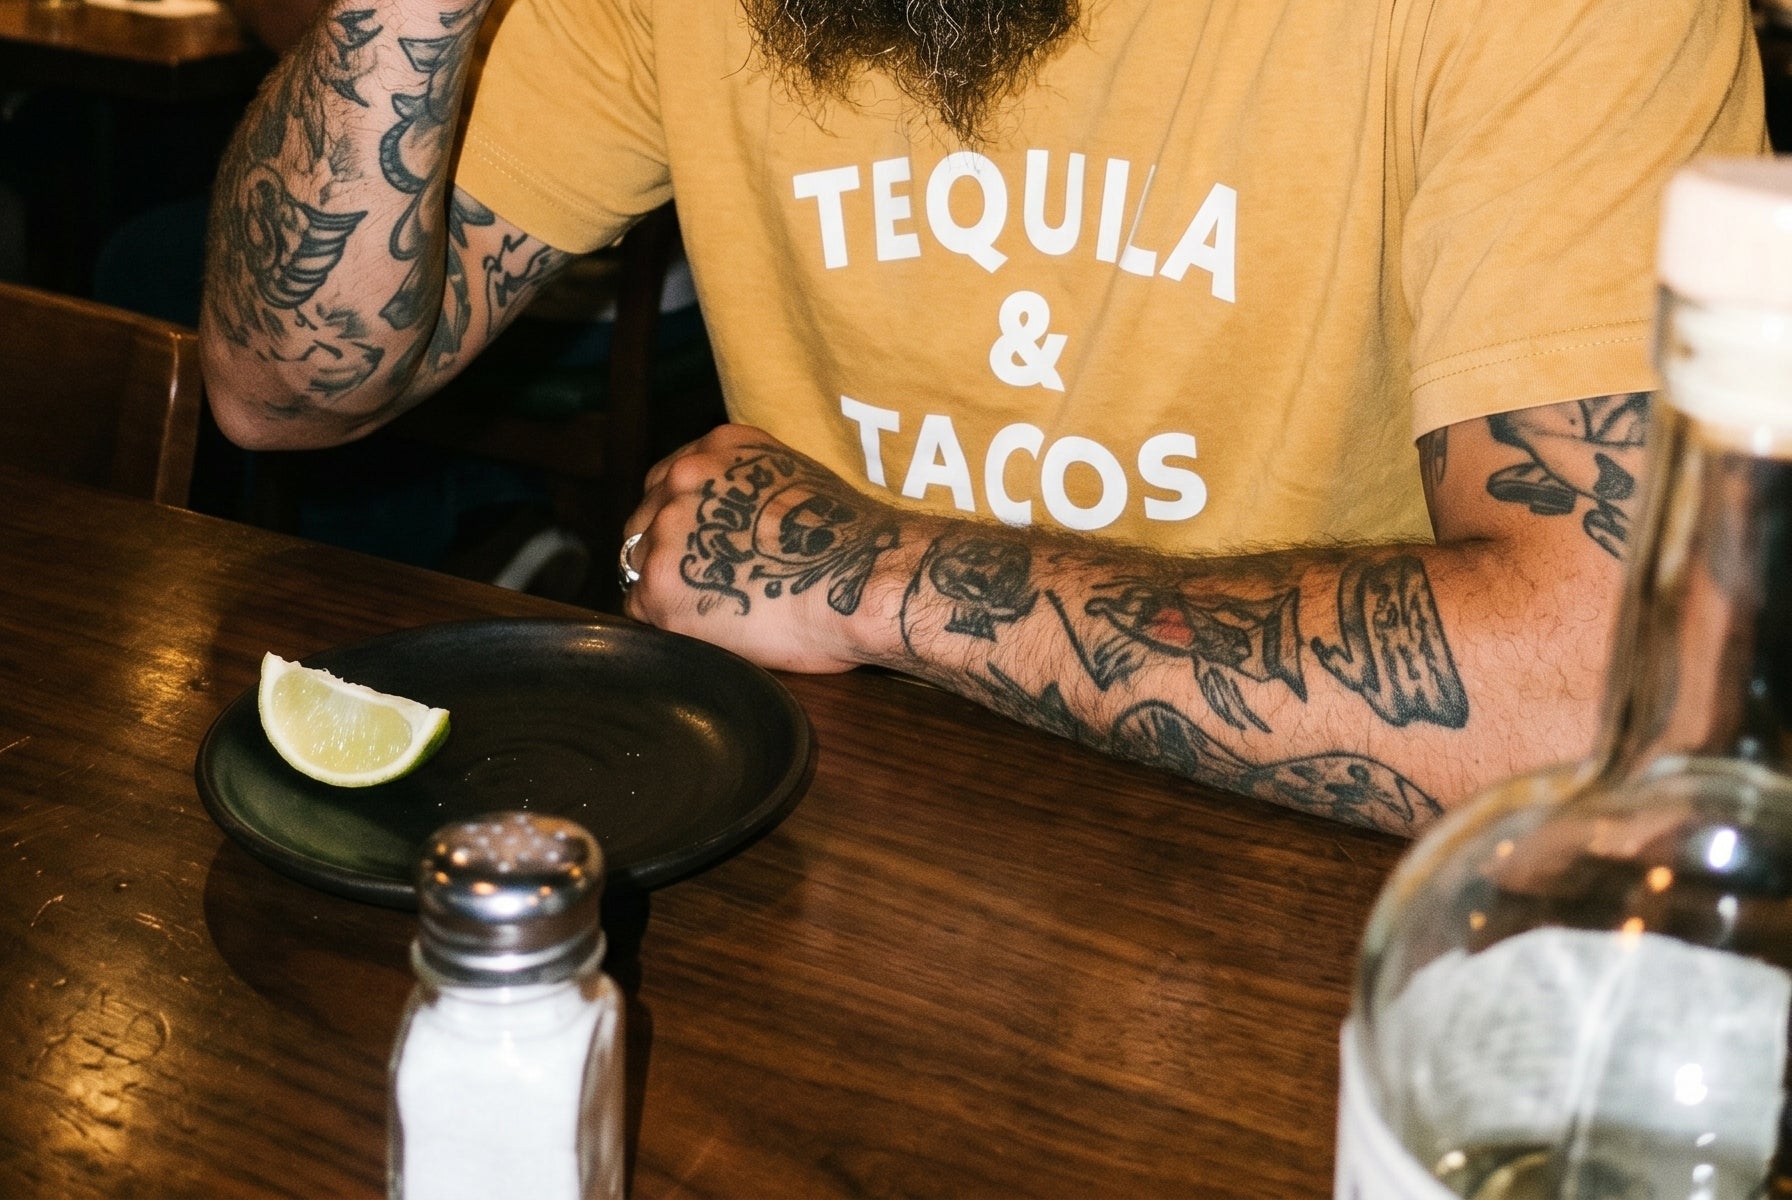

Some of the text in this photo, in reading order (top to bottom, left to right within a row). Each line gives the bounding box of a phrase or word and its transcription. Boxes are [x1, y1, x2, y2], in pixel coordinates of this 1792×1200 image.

[792, 148, 1238, 304] TEQUILA
[988, 290, 1069, 392] &
[840, 395, 1208, 531] TACOS
